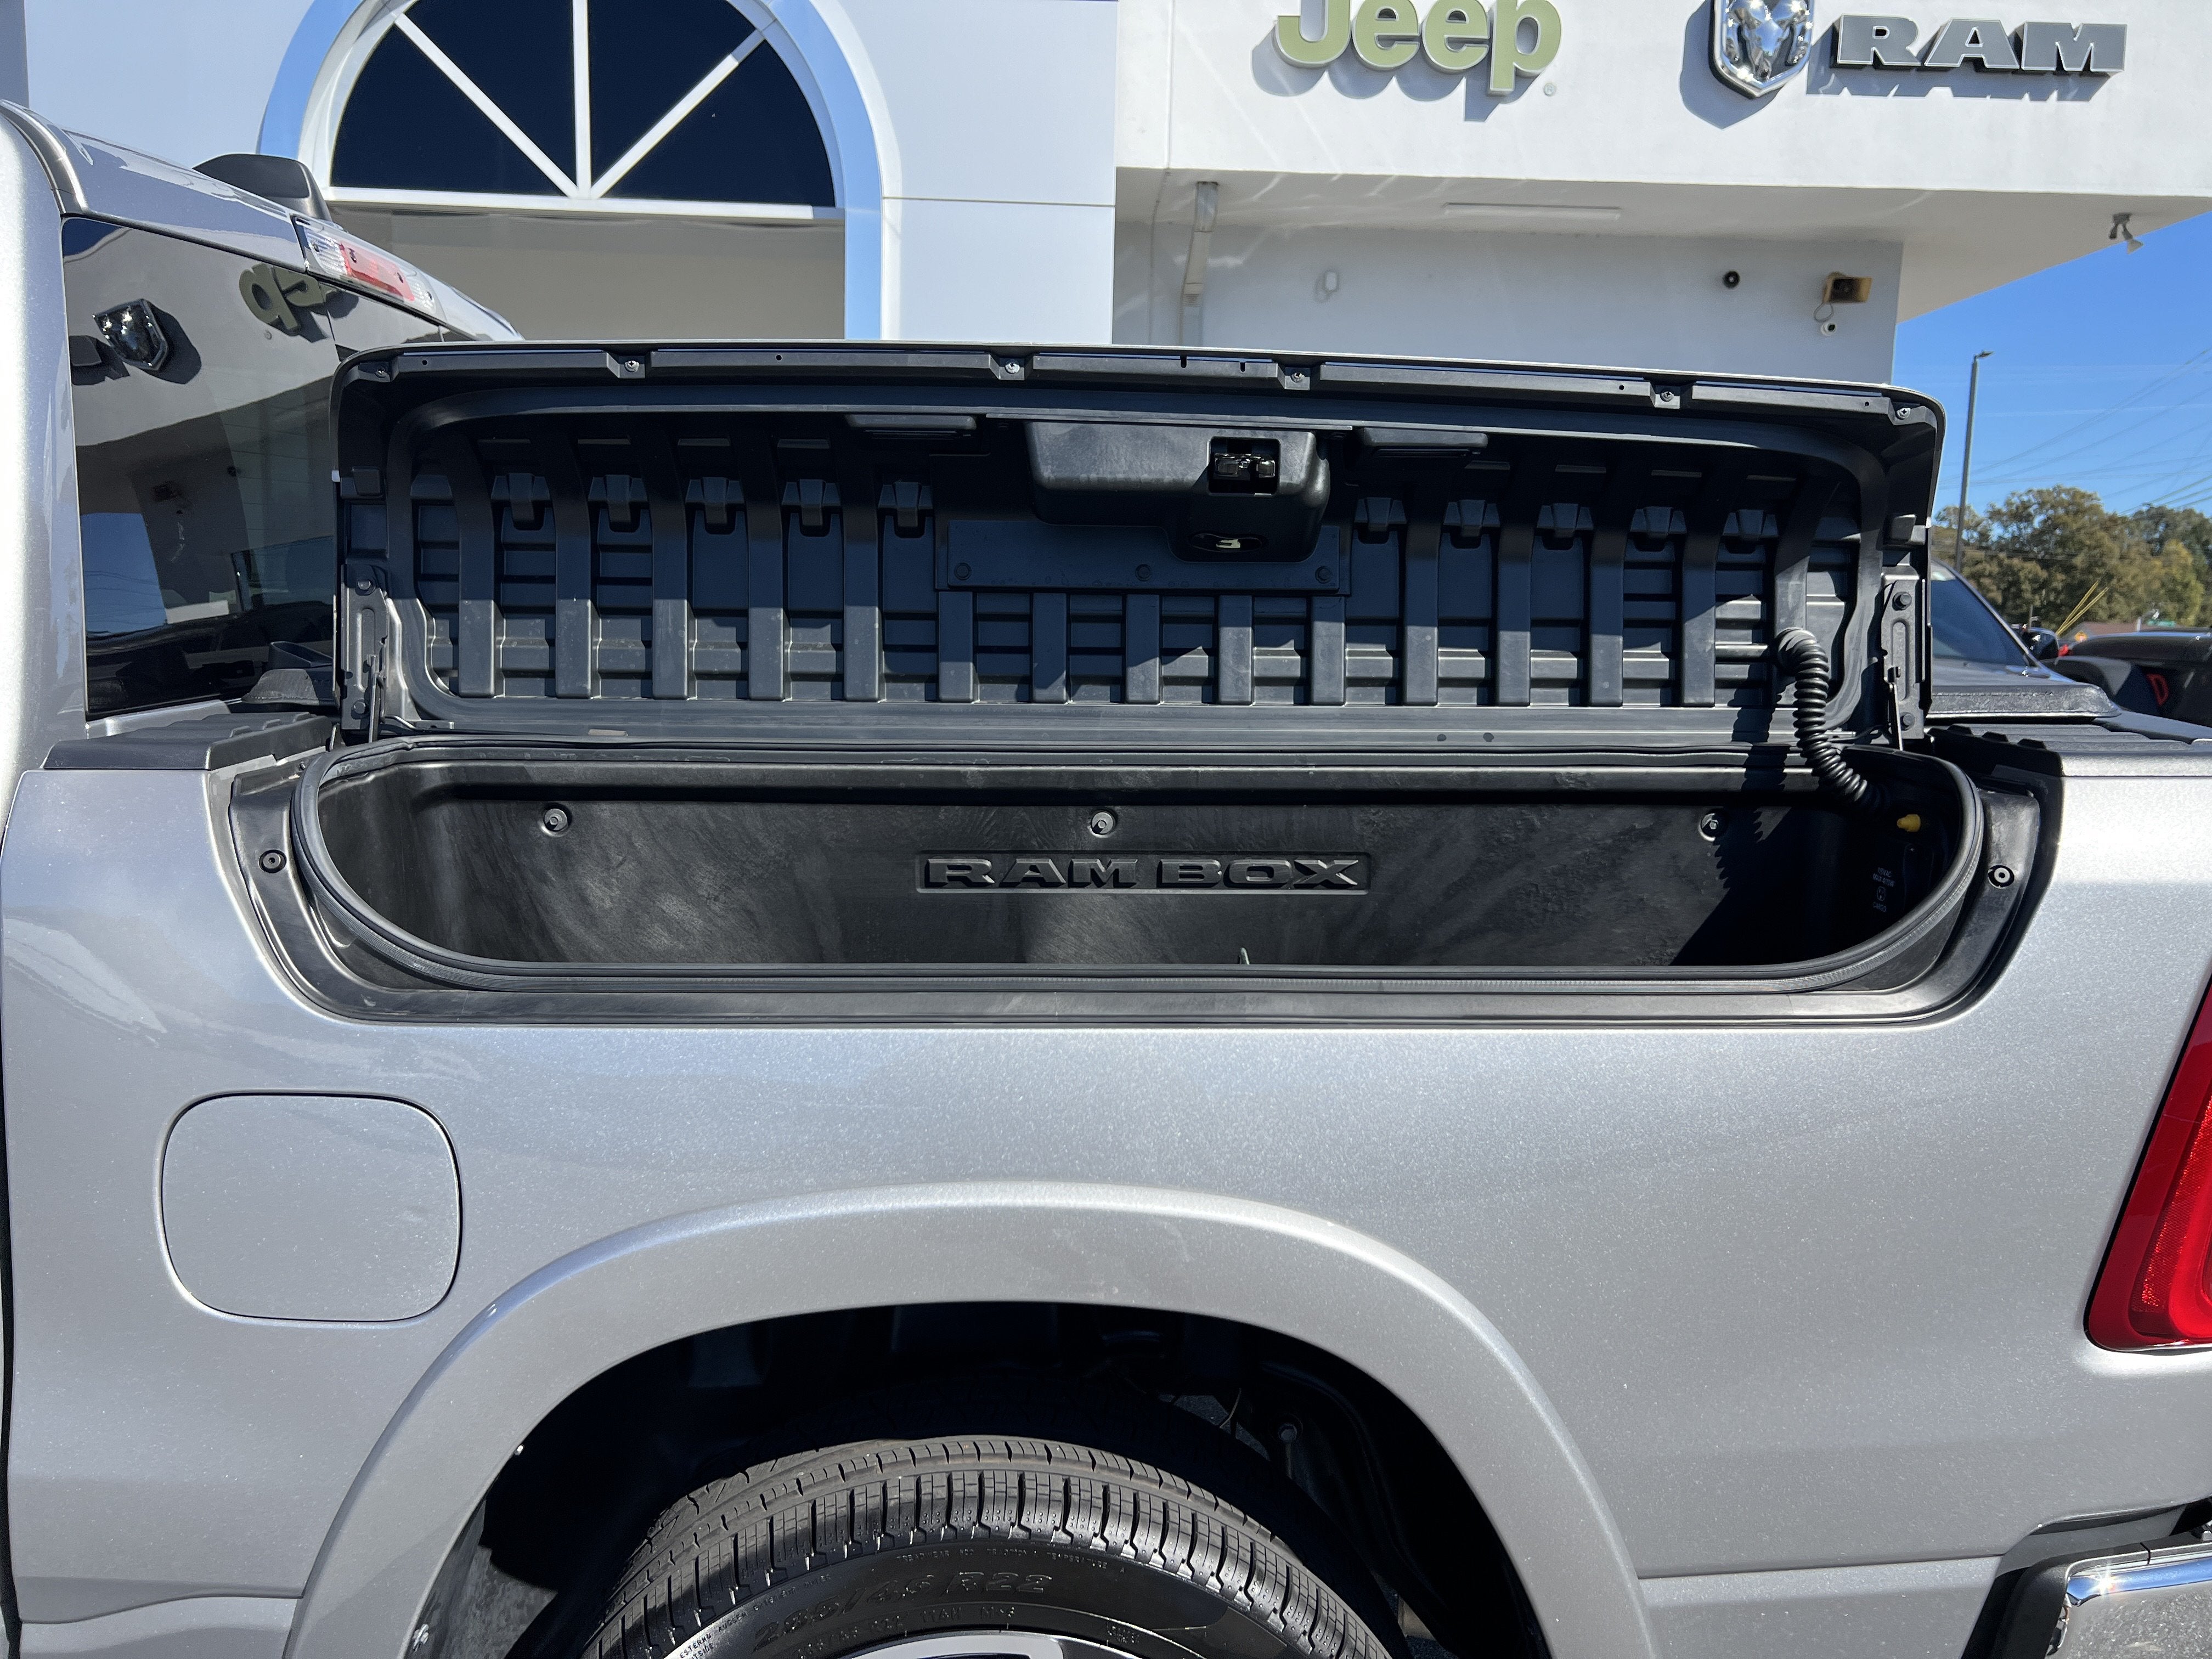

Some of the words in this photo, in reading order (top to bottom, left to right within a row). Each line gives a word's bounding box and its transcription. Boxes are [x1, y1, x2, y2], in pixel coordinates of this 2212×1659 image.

[1276, 0, 1563, 92] Jeep
[1837, 13, 2127, 71] RAM
[924, 858, 1137, 888] RAM
[1156, 859, 1358, 888] BOX
[896, 1550, 950, 1562] TREADWEAR
[1046, 1551, 1108, 1570] TEMPERATURE
[945, 1571, 1053, 1595] R22
